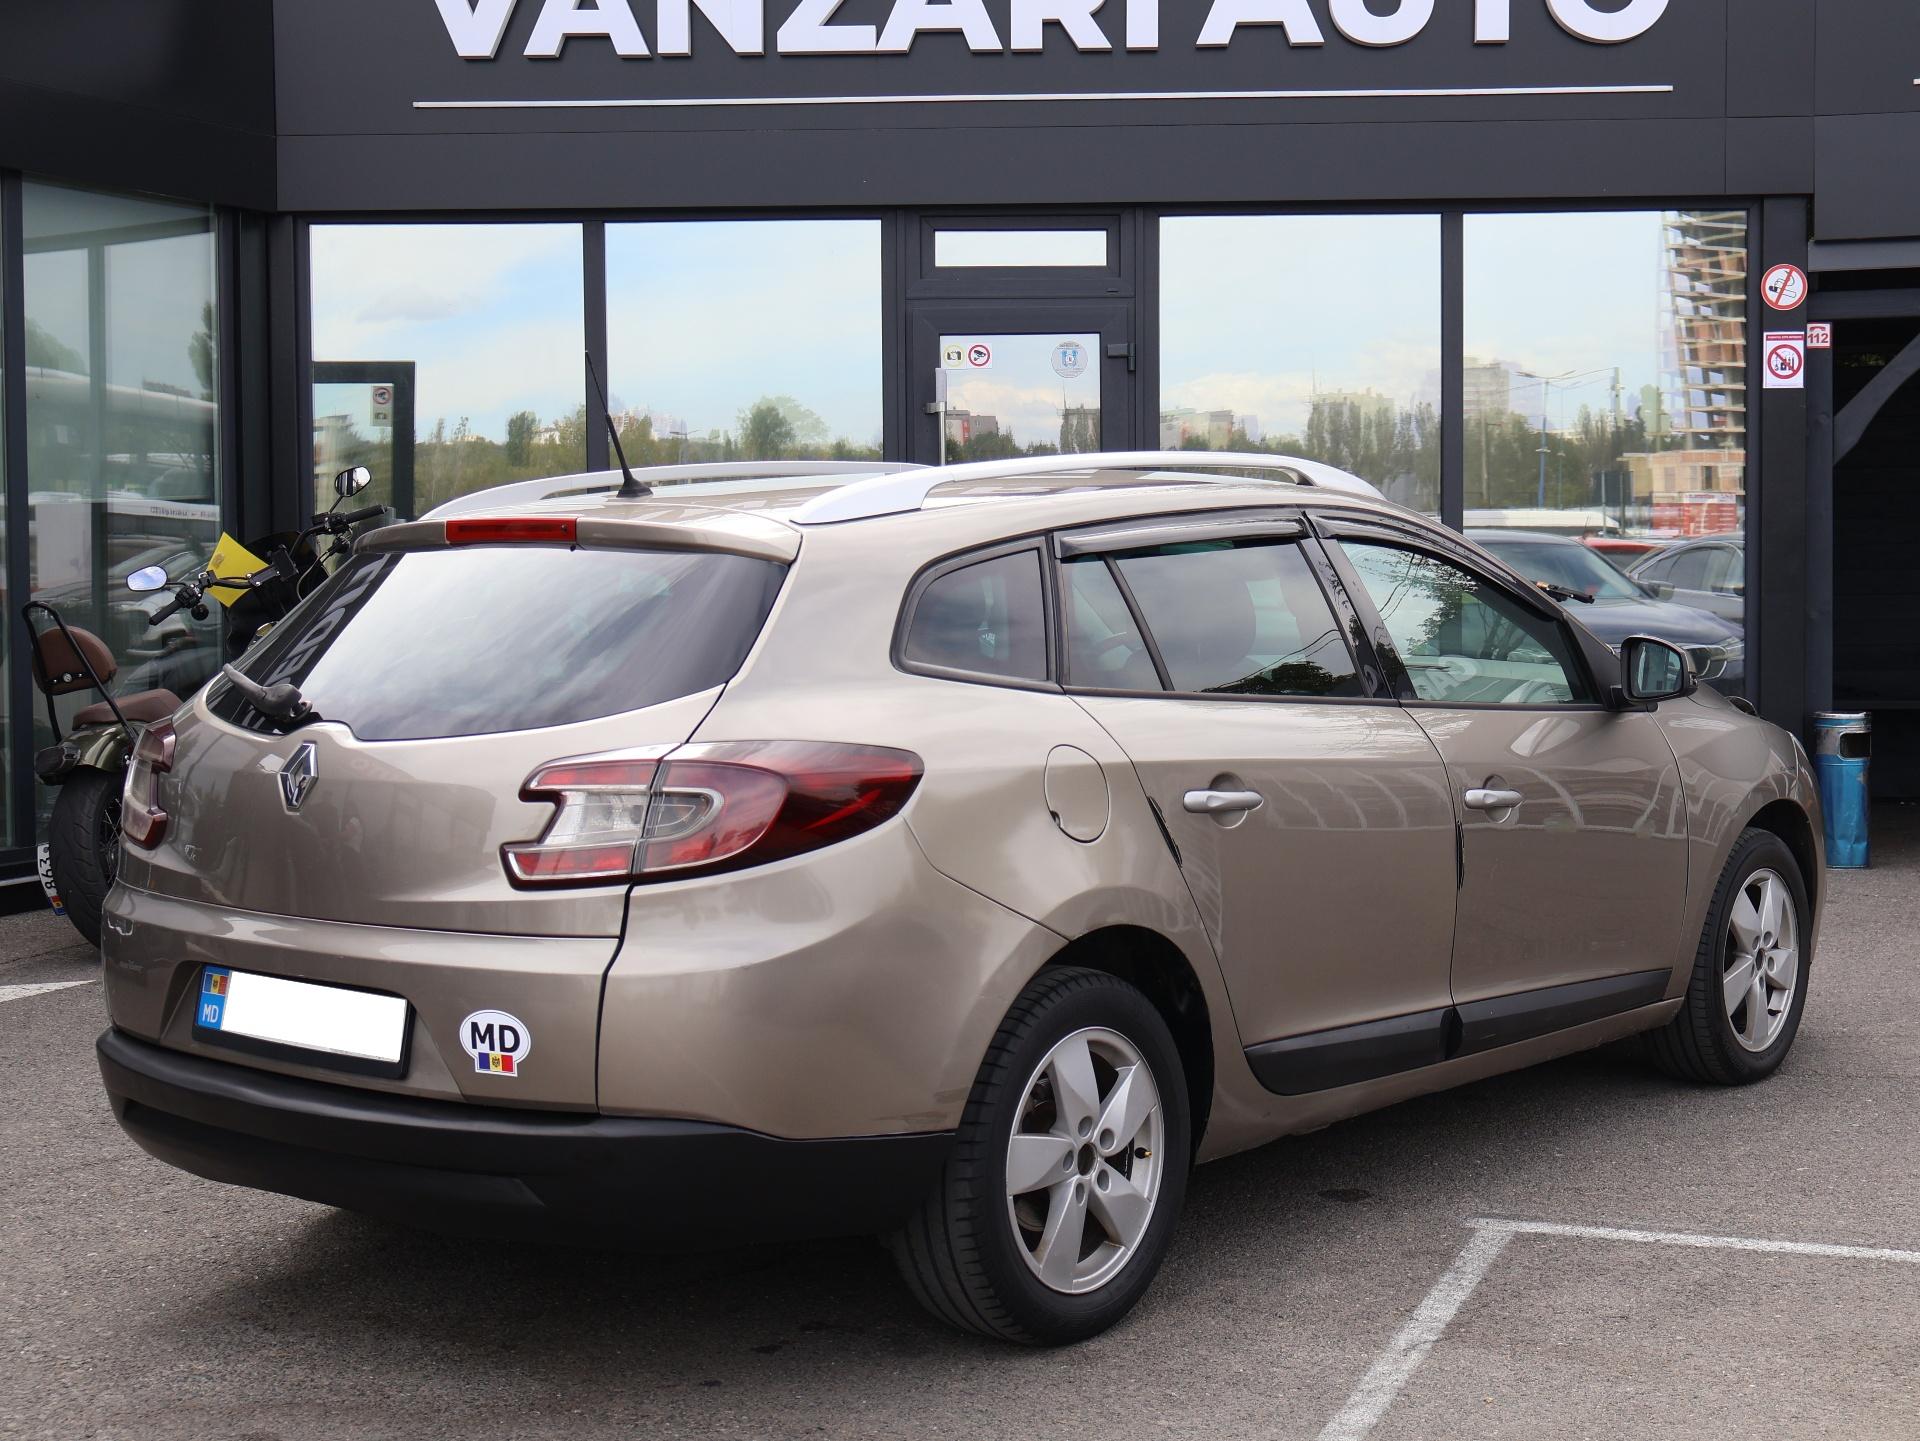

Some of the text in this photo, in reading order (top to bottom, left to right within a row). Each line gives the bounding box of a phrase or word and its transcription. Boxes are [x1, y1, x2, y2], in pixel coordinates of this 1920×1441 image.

[1808, 333, 1829, 344] 112
[202, 1003, 219, 1023] MD
[470, 1021, 520, 1053] MD
